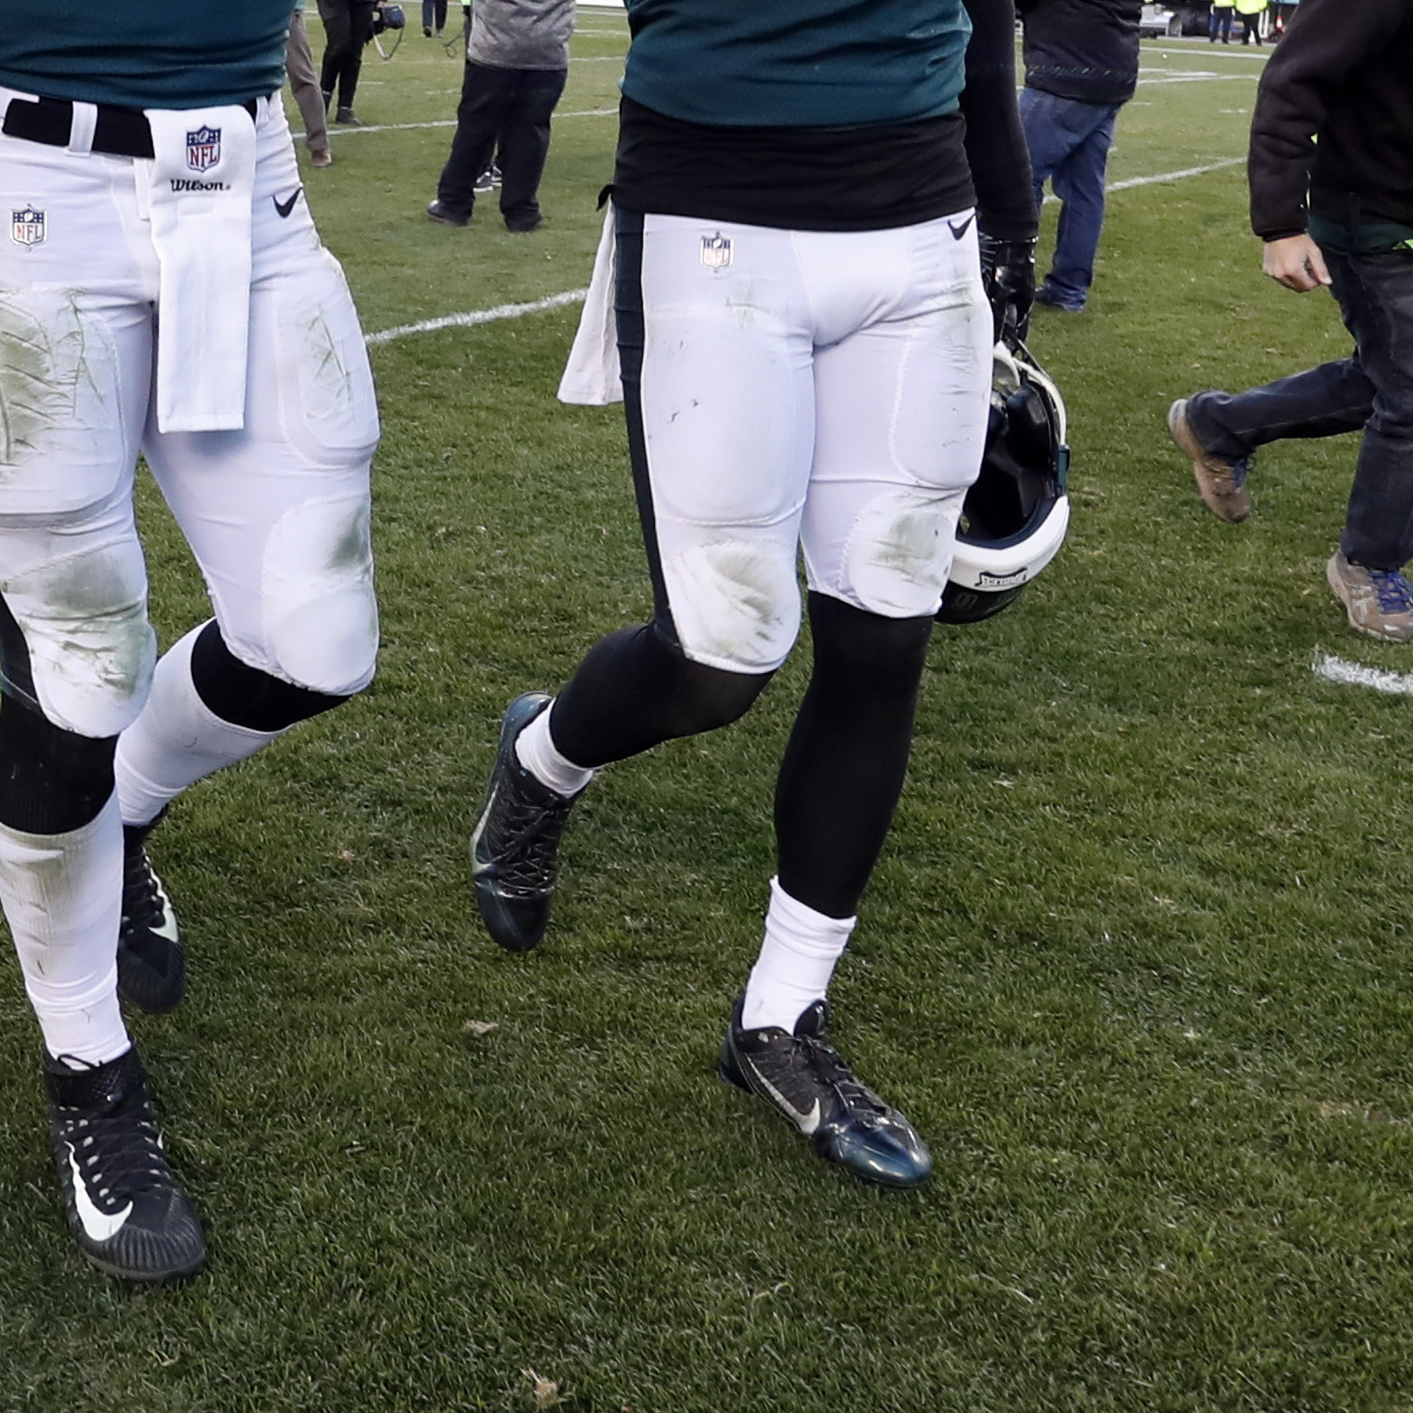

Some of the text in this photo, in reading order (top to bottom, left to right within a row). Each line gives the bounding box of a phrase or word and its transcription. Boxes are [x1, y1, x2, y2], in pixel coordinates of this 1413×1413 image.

[189, 145, 219, 169] NFL
[170, 178, 224, 193] Wilson
[15, 223, 42, 242] NFL
